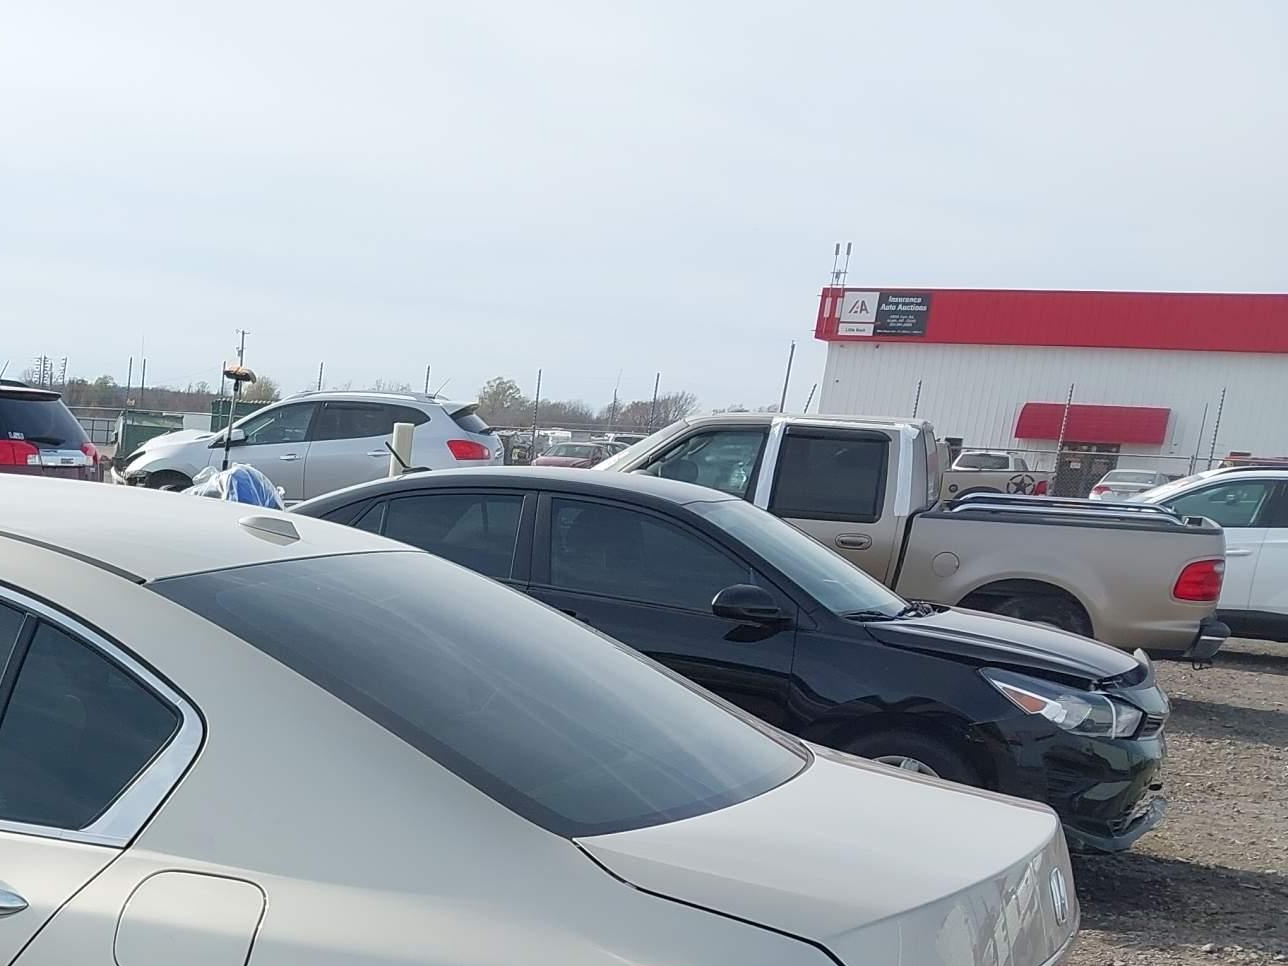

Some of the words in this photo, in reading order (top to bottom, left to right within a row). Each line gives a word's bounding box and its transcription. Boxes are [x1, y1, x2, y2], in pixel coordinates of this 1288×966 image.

[888, 295, 922, 303] Insurance
[880, 303, 896, 311] Auto
[897, 303, 927, 311] Auctions
